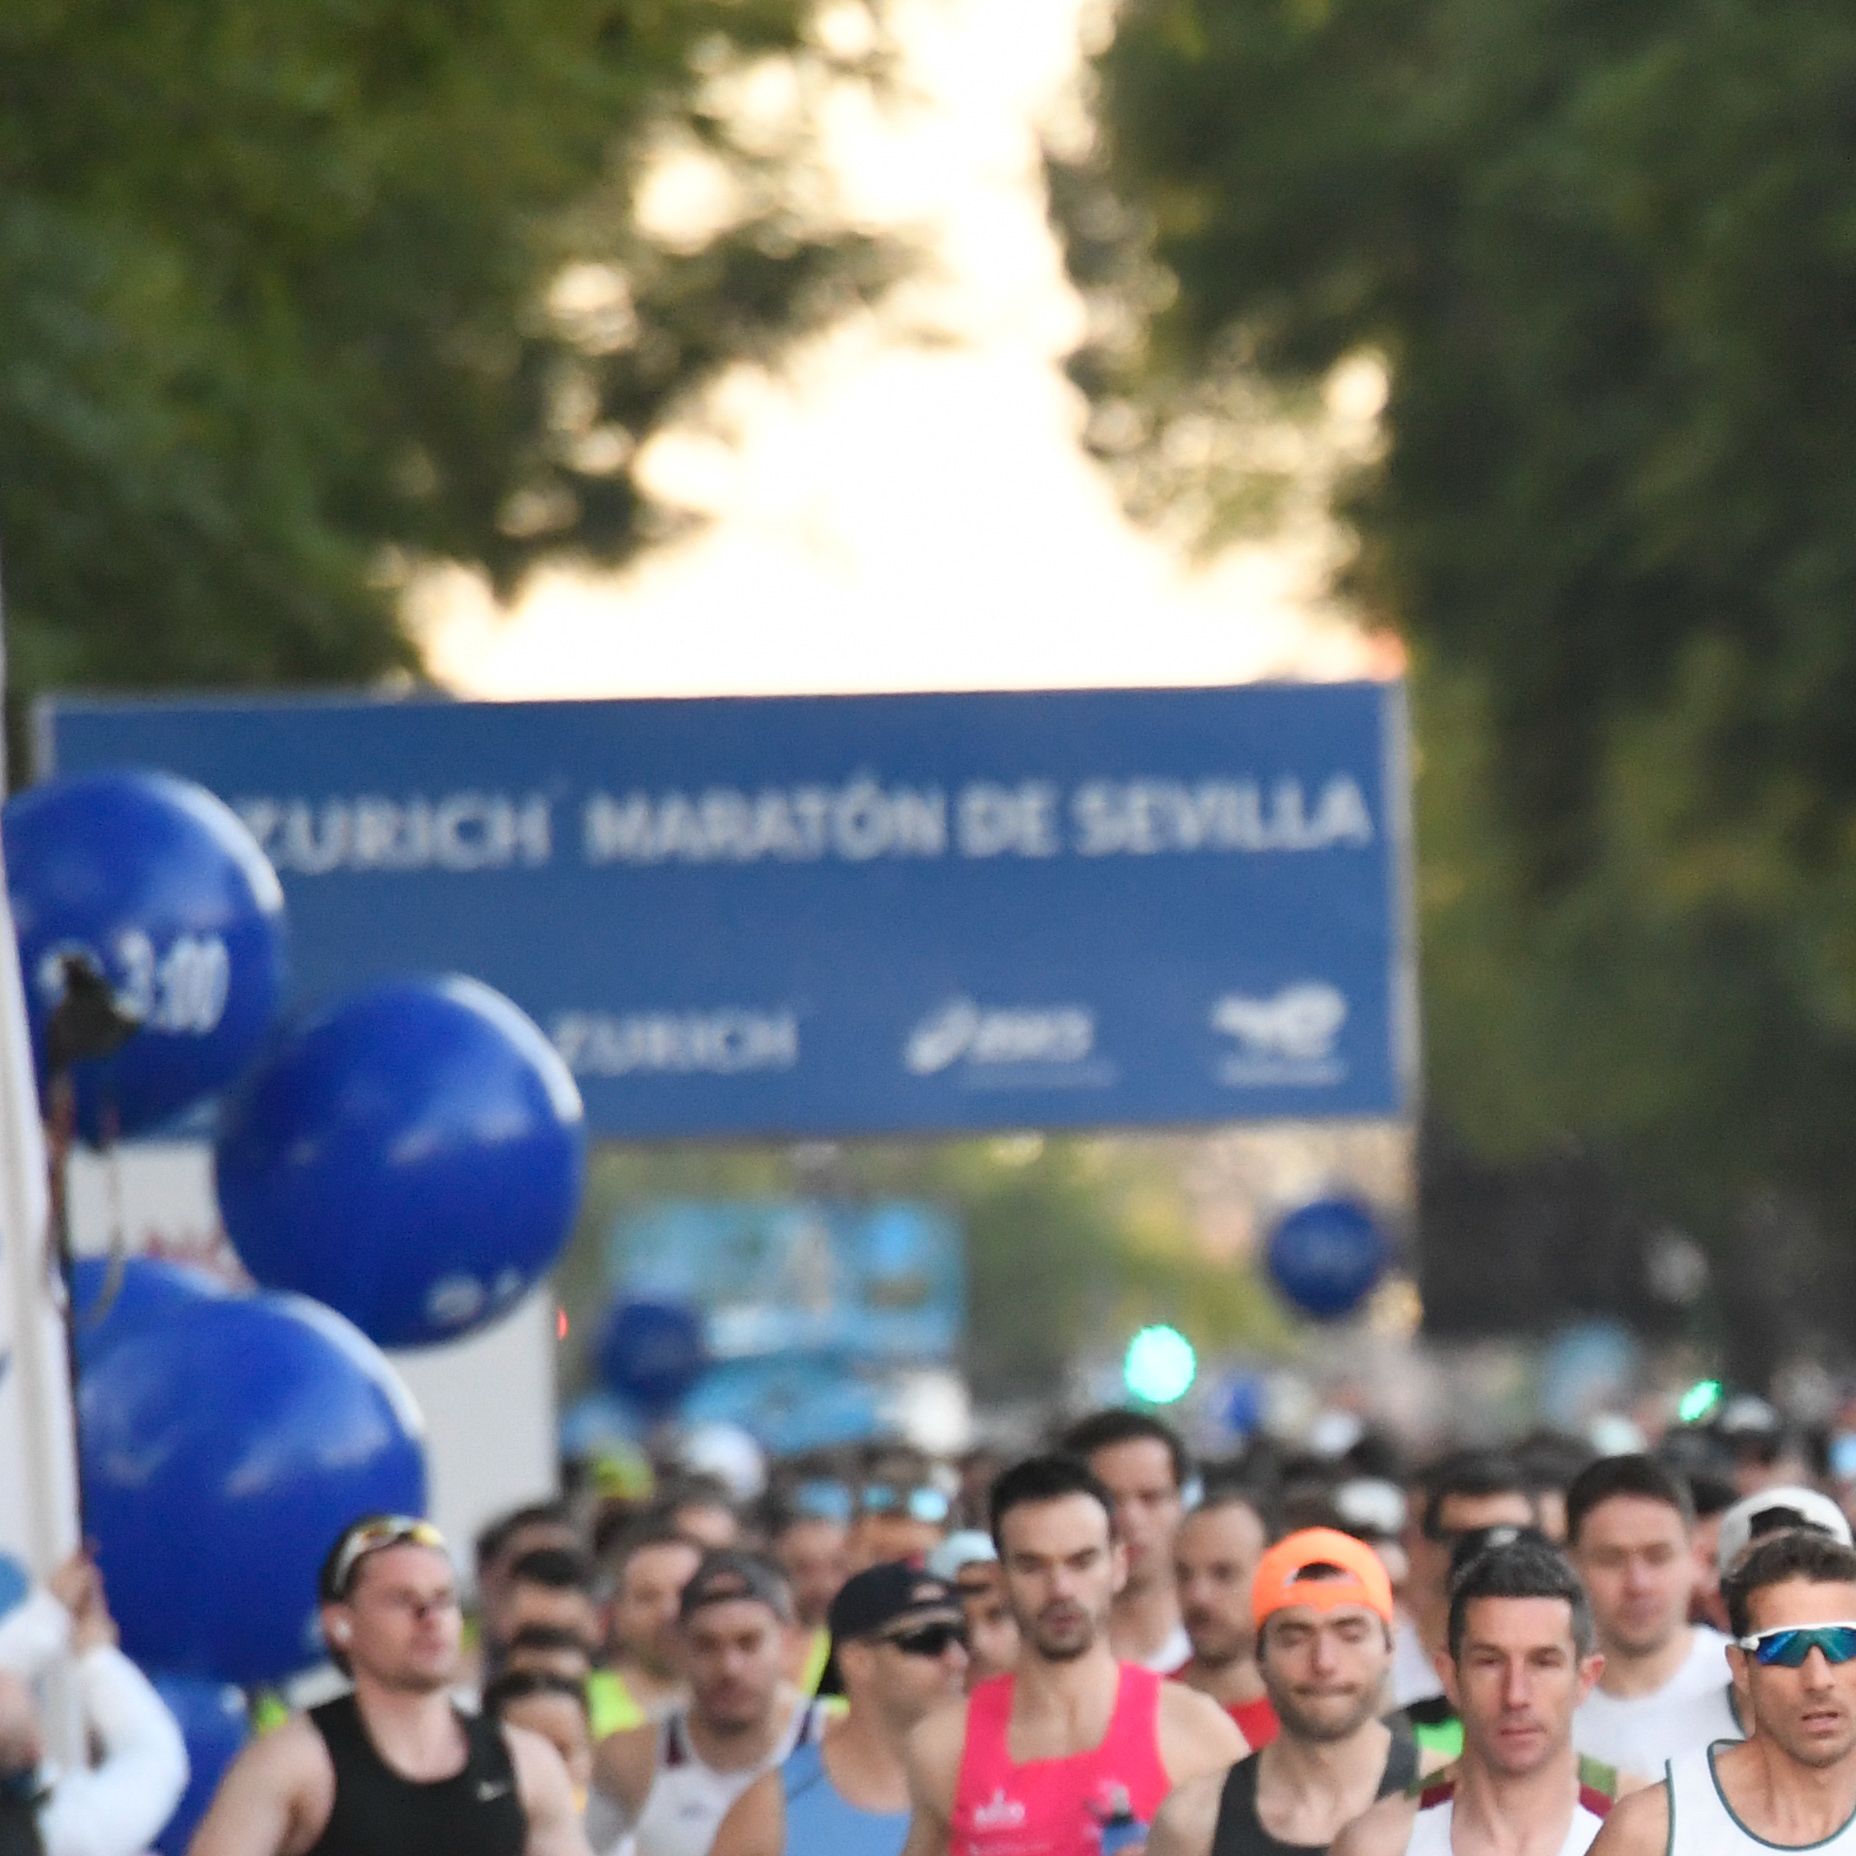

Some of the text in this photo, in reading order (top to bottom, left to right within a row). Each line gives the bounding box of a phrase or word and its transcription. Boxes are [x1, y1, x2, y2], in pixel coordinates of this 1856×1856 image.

[232, 768, 1374, 873] ZURICH MARATÓN DE SEVILLA
